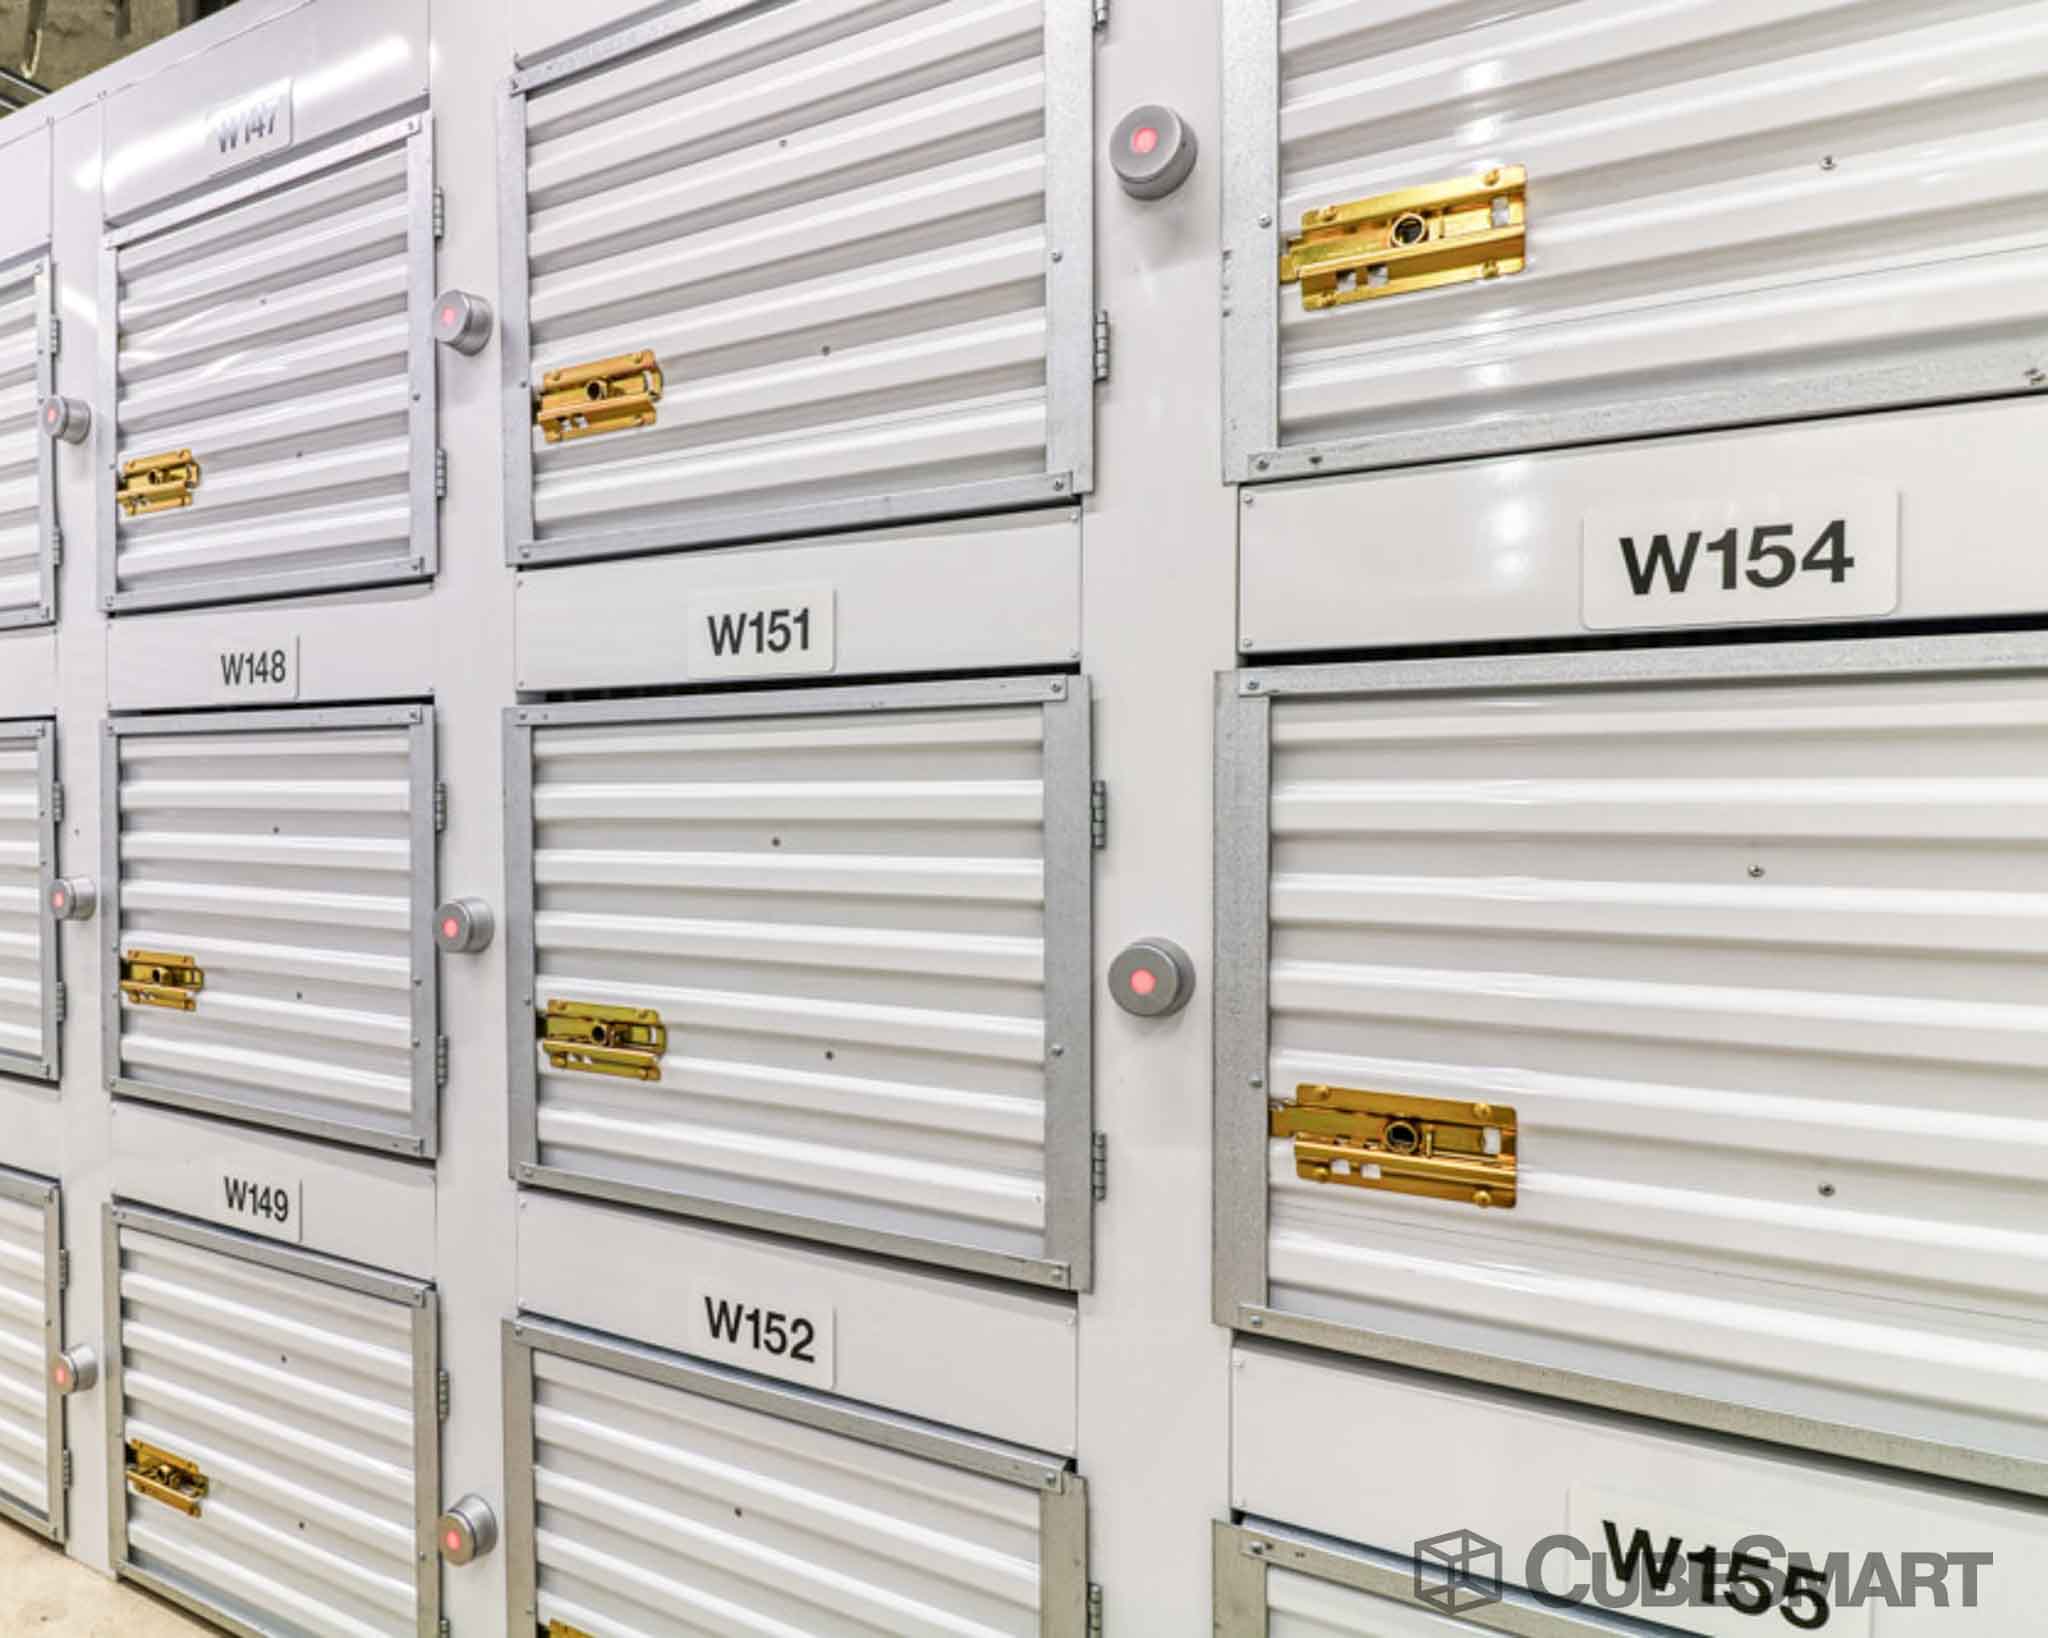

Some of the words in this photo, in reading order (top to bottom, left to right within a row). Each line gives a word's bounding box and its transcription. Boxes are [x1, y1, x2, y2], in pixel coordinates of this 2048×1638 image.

[214, 106, 277, 153] W147
[1619, 519, 1855, 596] W154
[707, 606, 810, 657] W151
[220, 649, 286, 686] W148
[223, 1176, 289, 1223] W149
[704, 1295, 815, 1363] W152
[1602, 1520, 1831, 1630] W155
